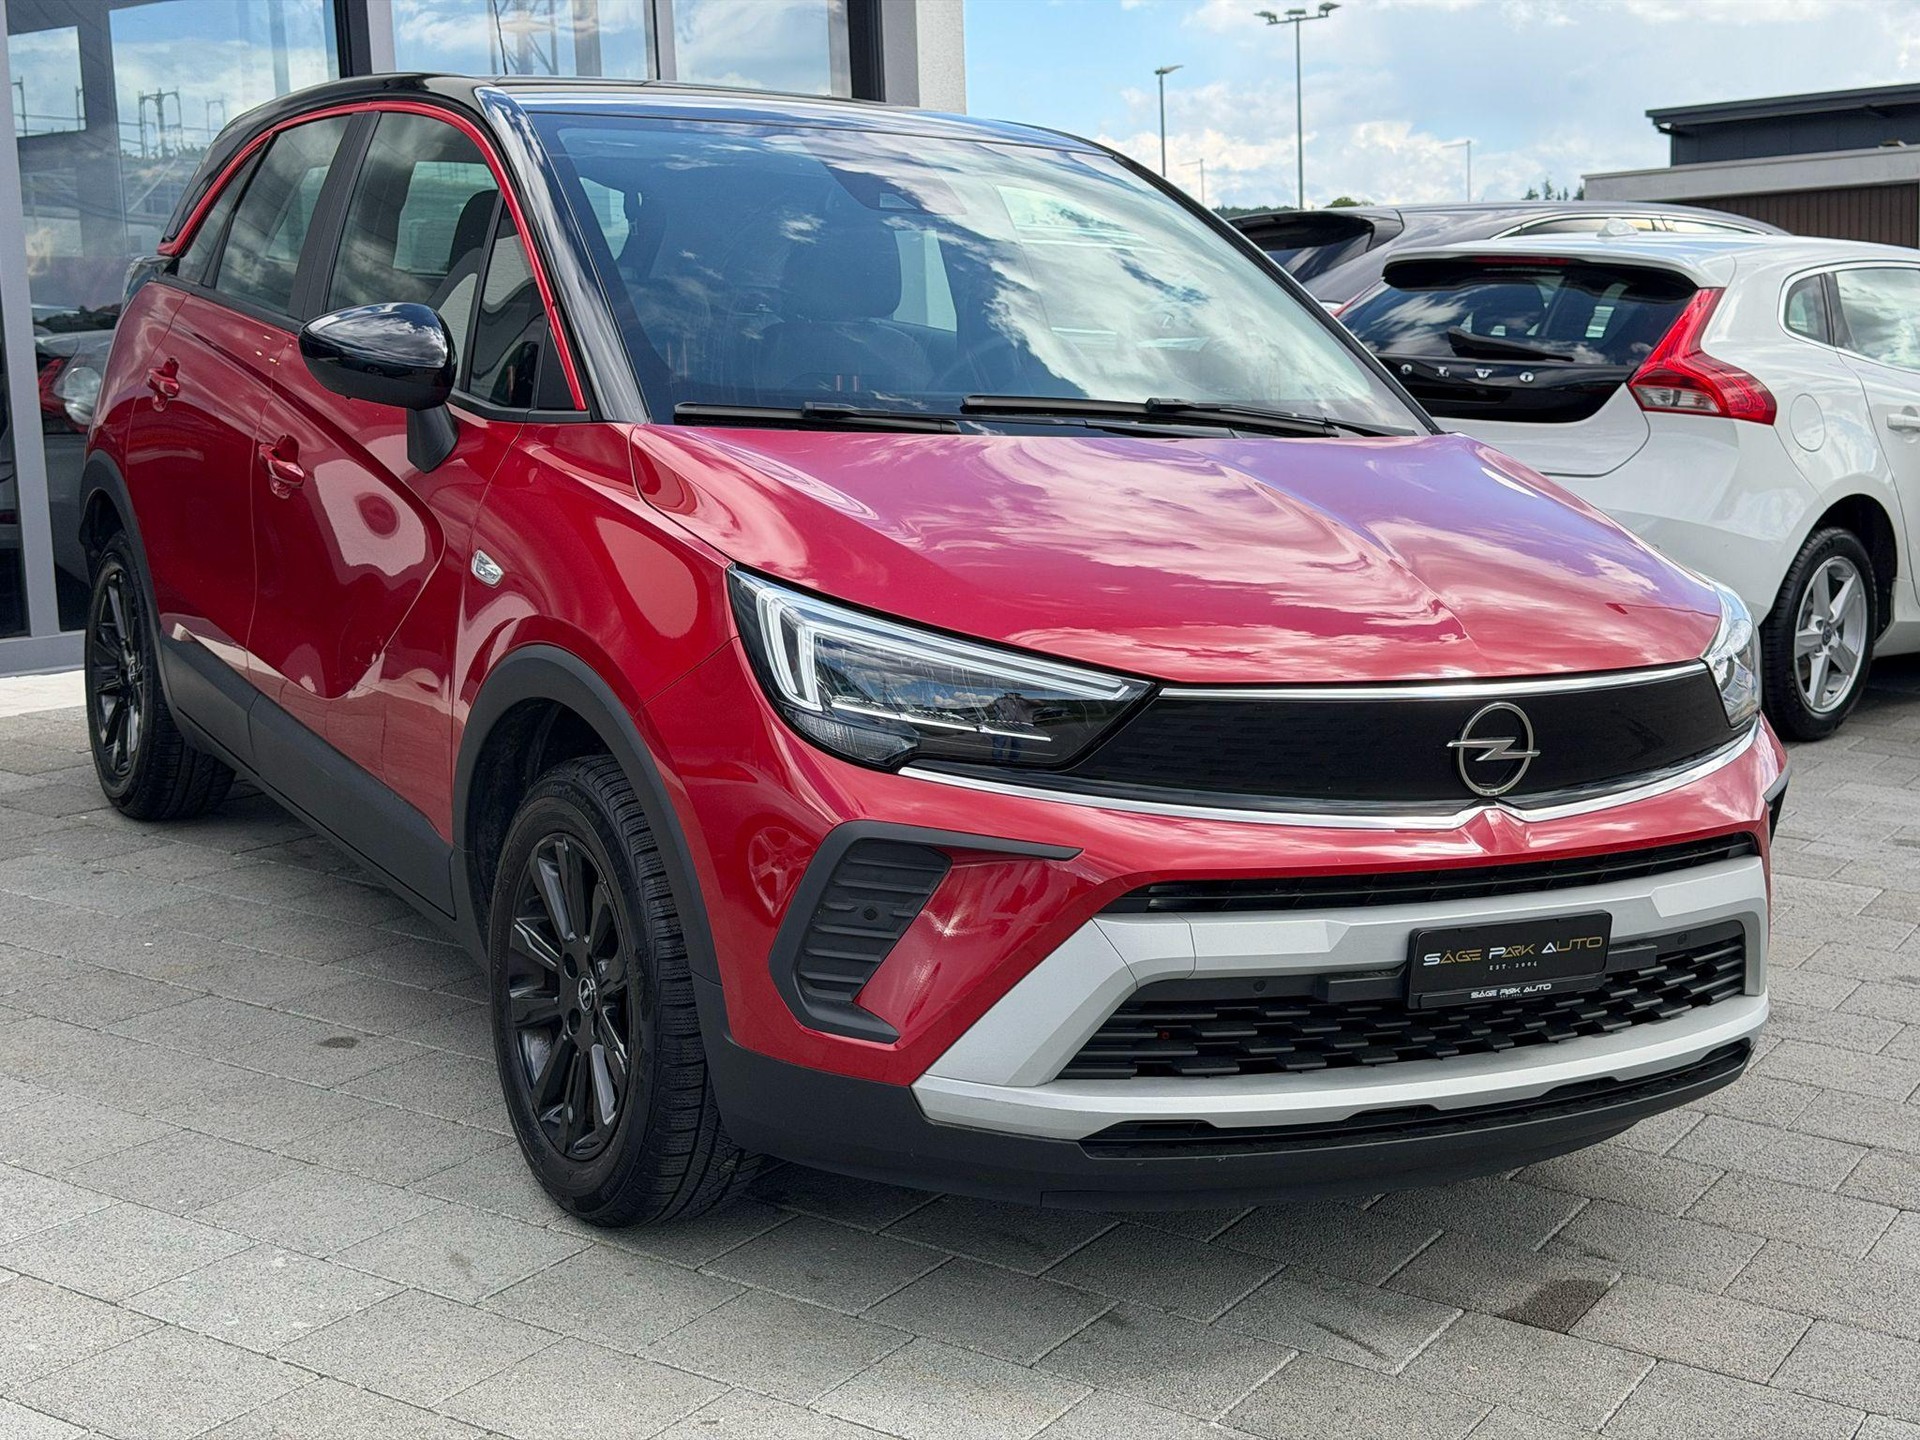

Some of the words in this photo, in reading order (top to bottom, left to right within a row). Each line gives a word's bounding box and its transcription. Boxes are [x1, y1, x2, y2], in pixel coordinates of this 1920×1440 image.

[1400, 364, 1535, 383] OLVO
[1489, 943, 1535, 960] PARK
[1541, 936, 1602, 954] AUTO
[1523, 983, 1552, 993] AUTO
